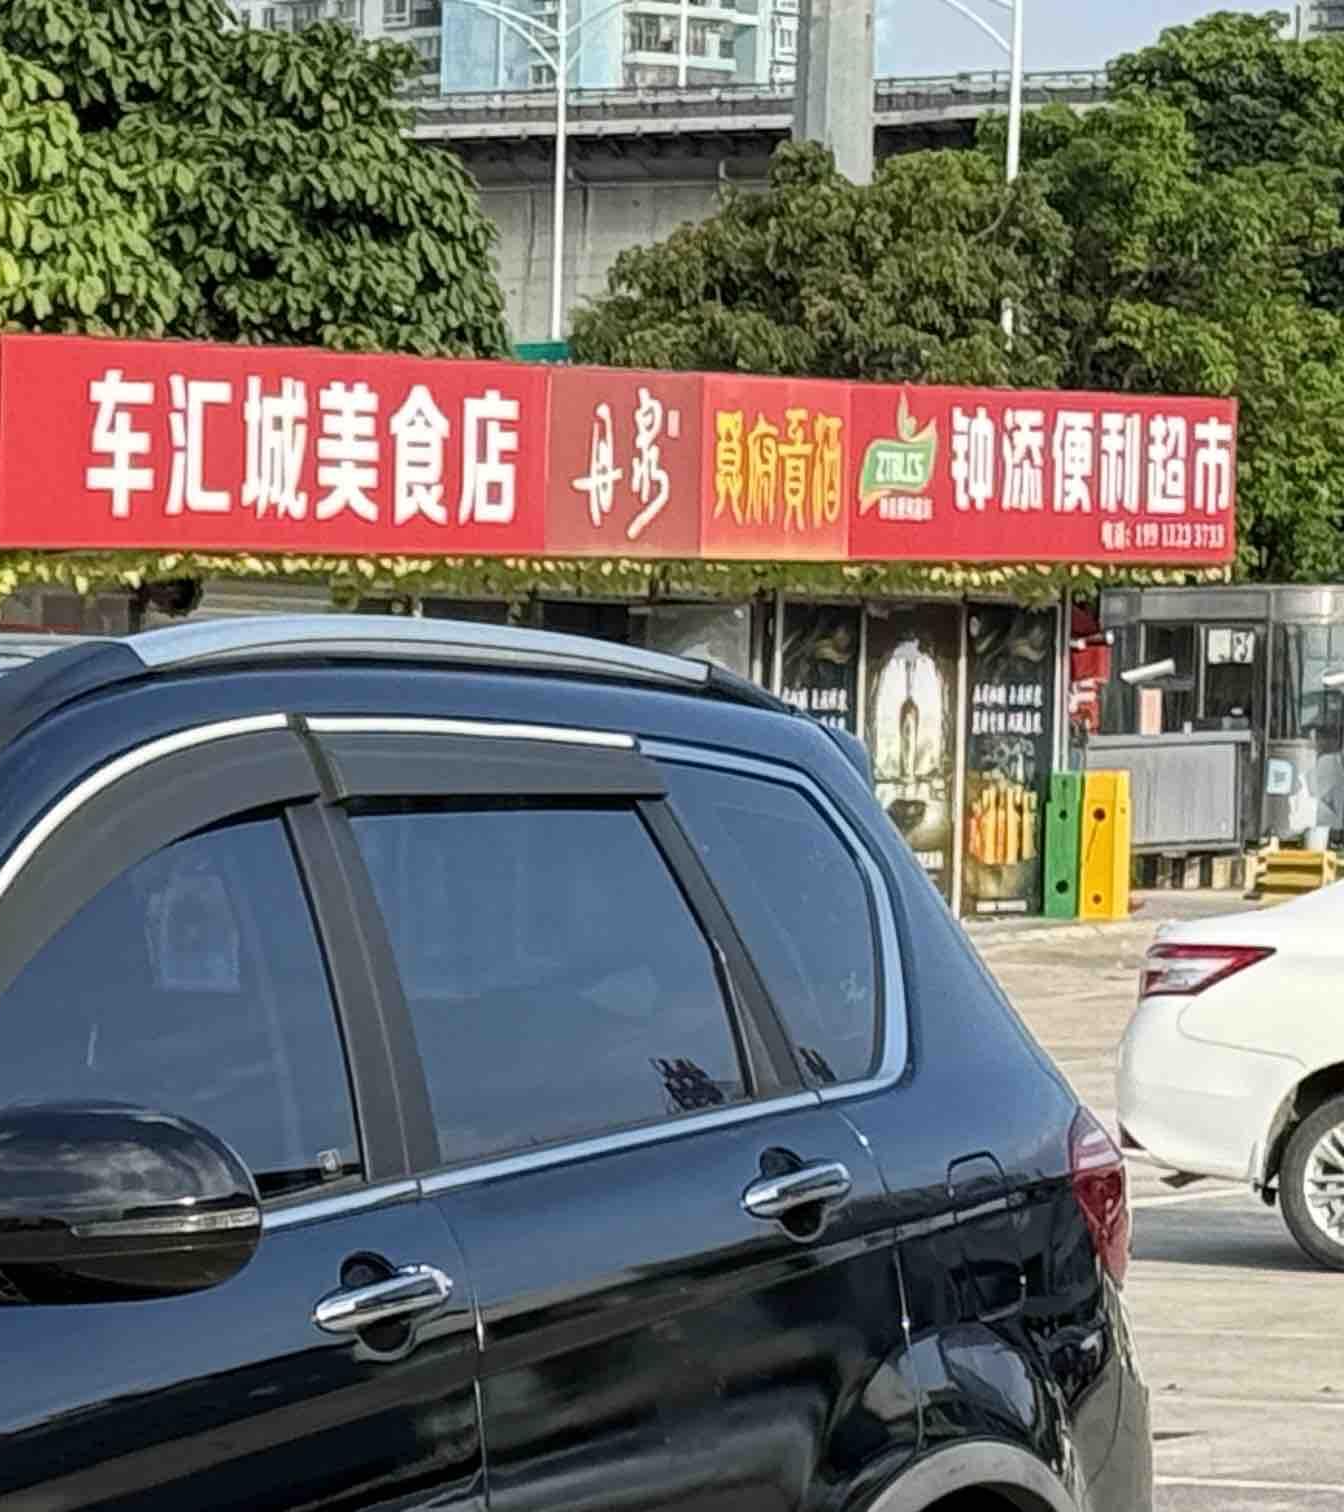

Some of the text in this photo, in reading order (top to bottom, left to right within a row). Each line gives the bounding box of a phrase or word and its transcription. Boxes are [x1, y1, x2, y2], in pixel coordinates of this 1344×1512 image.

[85, 369, 522, 527] 车汇城美食店
[949, 405, 1234, 516] 钟添便利超市
